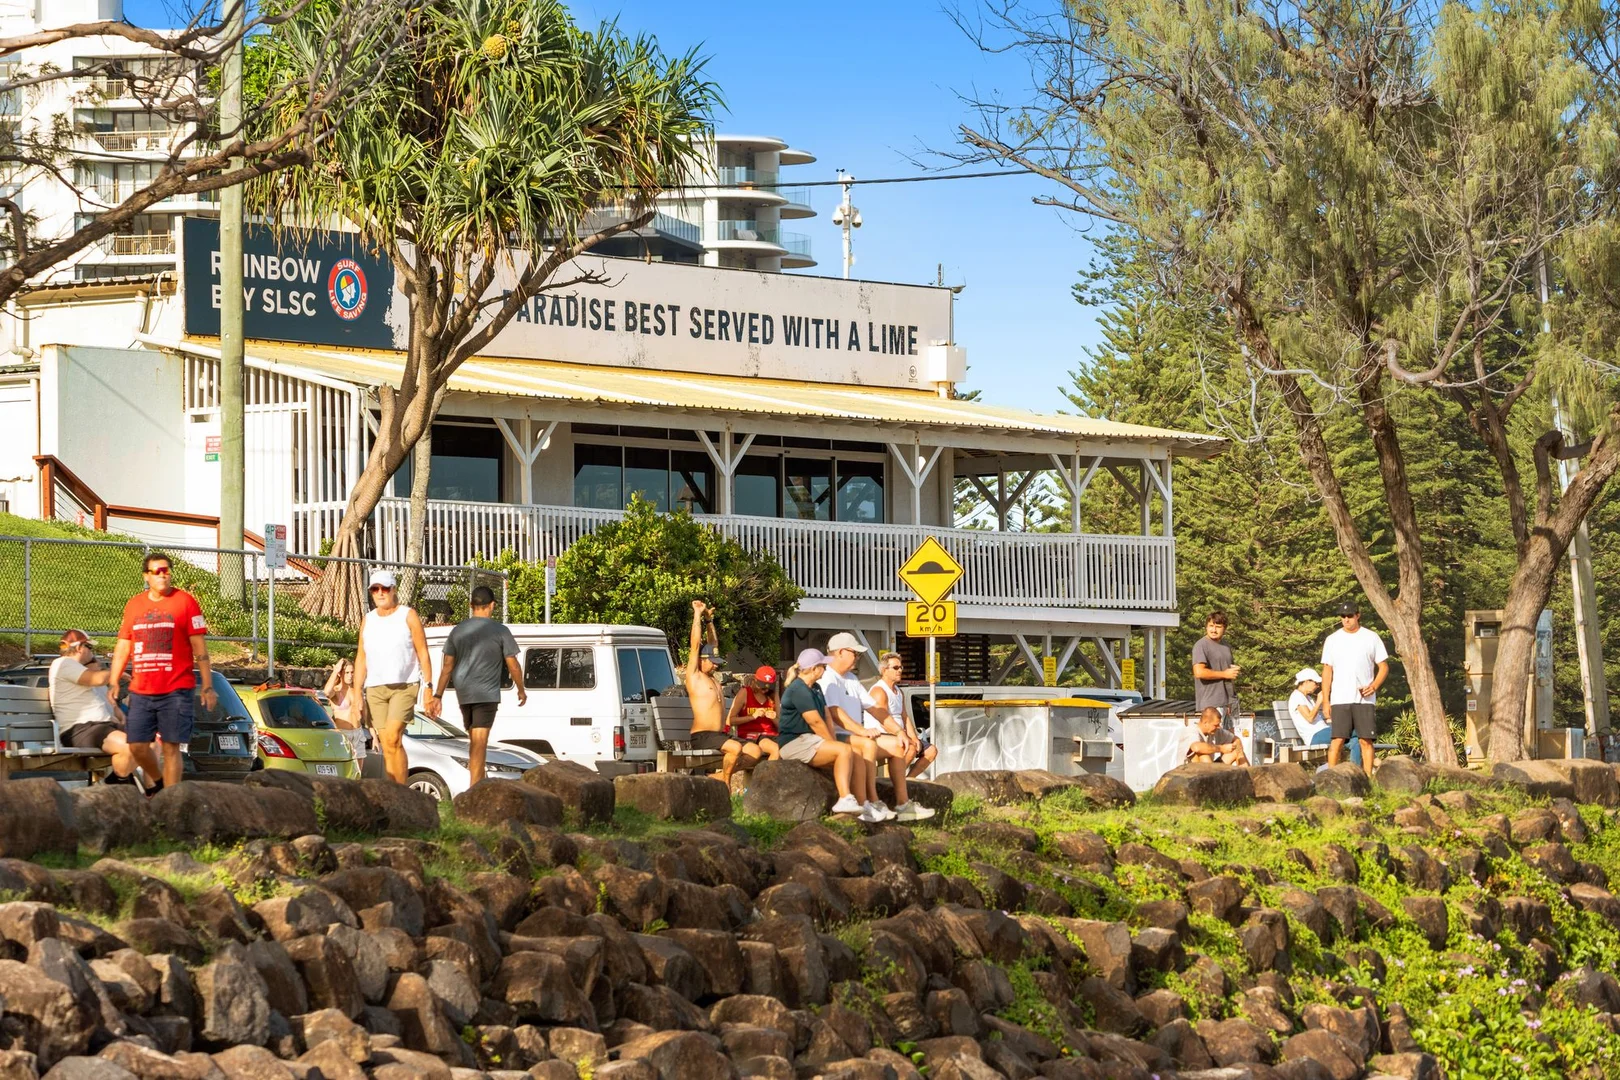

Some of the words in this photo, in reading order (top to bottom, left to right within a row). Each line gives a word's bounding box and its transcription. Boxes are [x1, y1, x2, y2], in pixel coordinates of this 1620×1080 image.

[211, 251, 321, 284] RINBOW
[337, 259, 361, 272] SURF
[212, 284, 256, 311] BY
[262, 289, 317, 317] SLSC
[329, 289, 341, 315] LIFE
[343, 292, 367, 319] SAVING
[625, 300, 681, 337] BEST
[690, 306, 774, 345] SERVED
[782, 315, 839, 350] WITH
[848, 321, 861, 352] A
[868, 322, 919, 356] LIME
[916, 604, 947, 623] 20
[919, 624, 943, 633] km/h
